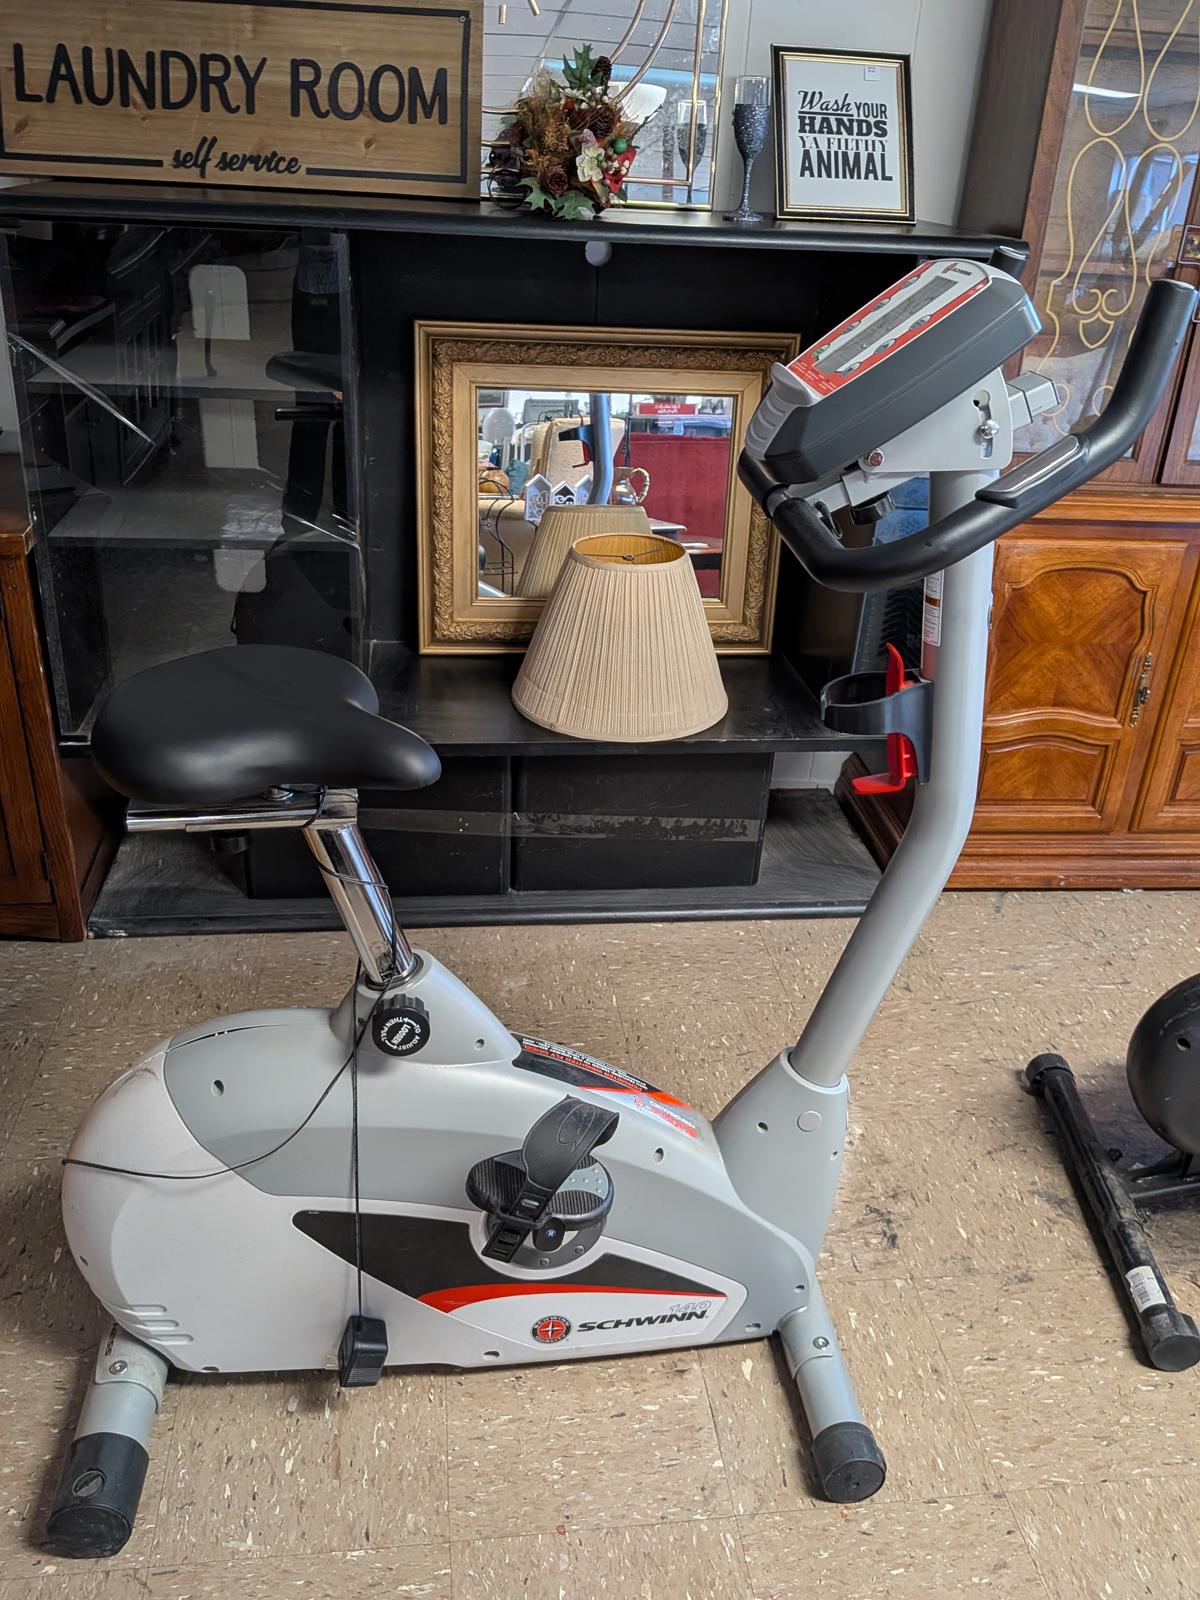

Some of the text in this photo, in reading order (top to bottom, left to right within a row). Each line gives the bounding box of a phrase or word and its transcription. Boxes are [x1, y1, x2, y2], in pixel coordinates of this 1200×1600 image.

[13, 43, 448, 125] LAUNDRY ROOM
[797, 90, 888, 119] Wash YOUR
[798, 115, 888, 138] HANDS
[172, 136, 301, 179] self service
[799, 149, 893, 181] ANIMAL
[577, 1310, 708, 1332] SCHWINN
[669, 1300, 711, 1315] 140
